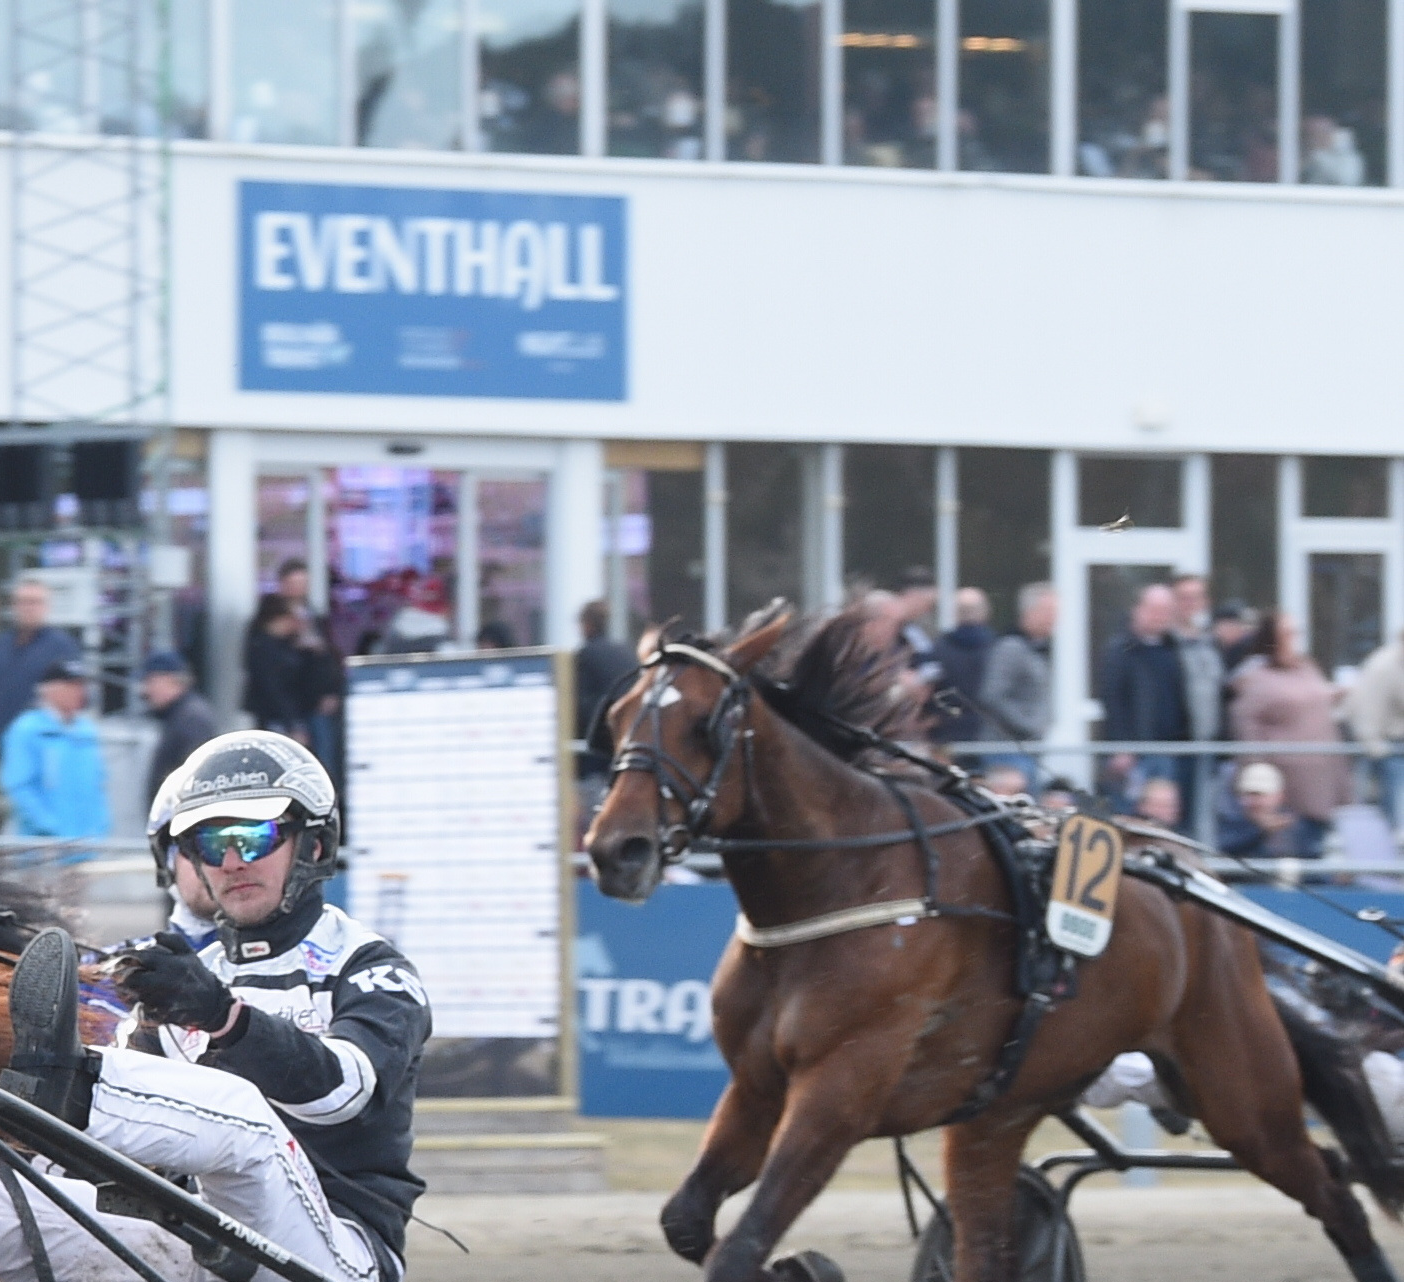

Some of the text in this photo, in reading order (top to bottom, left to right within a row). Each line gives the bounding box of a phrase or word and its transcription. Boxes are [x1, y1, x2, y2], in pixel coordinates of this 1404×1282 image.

[255, 211, 621, 310] EVENTHALL
[1065, 821, 1114, 911] 12
[218, 1212, 291, 1264] YANKEE
